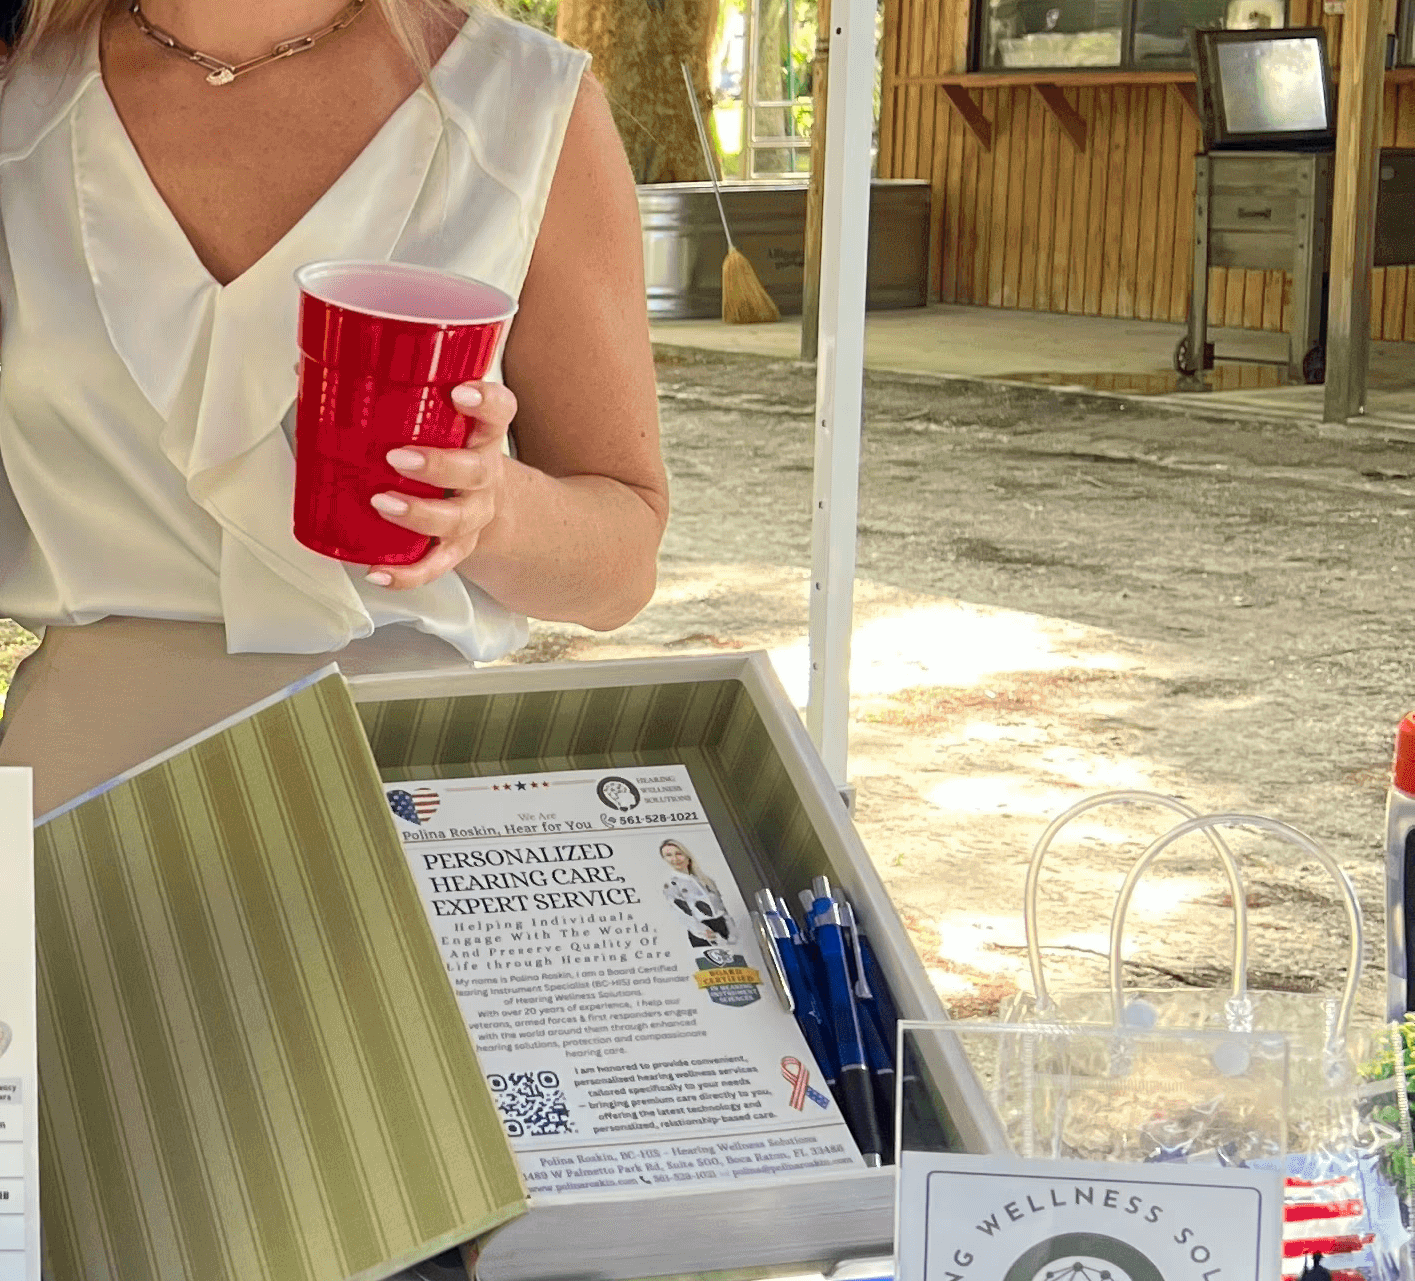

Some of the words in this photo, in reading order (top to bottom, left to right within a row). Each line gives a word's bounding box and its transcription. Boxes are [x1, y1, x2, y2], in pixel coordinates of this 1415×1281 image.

[619, 811, 699, 826] 561-528-1021
[402, 829, 446, 842] Polina
[450, 825, 501, 839] Roskin,
[504, 823, 537, 836] Hear
[542, 821, 562, 832] for
[568, 820, 593, 831] You
[423, 842, 613, 871] PERSONALIZED
[428, 870, 549, 893] HEARING
[551, 865, 626, 889] CARE,
[432, 893, 530, 917] EXPERT
[535, 887, 641, 911] SERVICE
[454, 918, 524, 933] Helping
[531, 911, 634, 927] Individuals
[441, 934, 502, 947] Engage
[511, 928, 551, 942] With
[559, 926, 590, 938] The
[449, 948, 480, 959] And
[489, 943, 562, 956] Preserve
[570, 938, 632, 952] Quality
[640, 936, 659, 946] Of
[446, 961, 478, 971] Life
[487, 956, 553, 970] through
[561, 951, 627, 964] Hearing
[635, 949, 671, 959] Care
[975, 1186, 1164, 1237] WELLNESS
